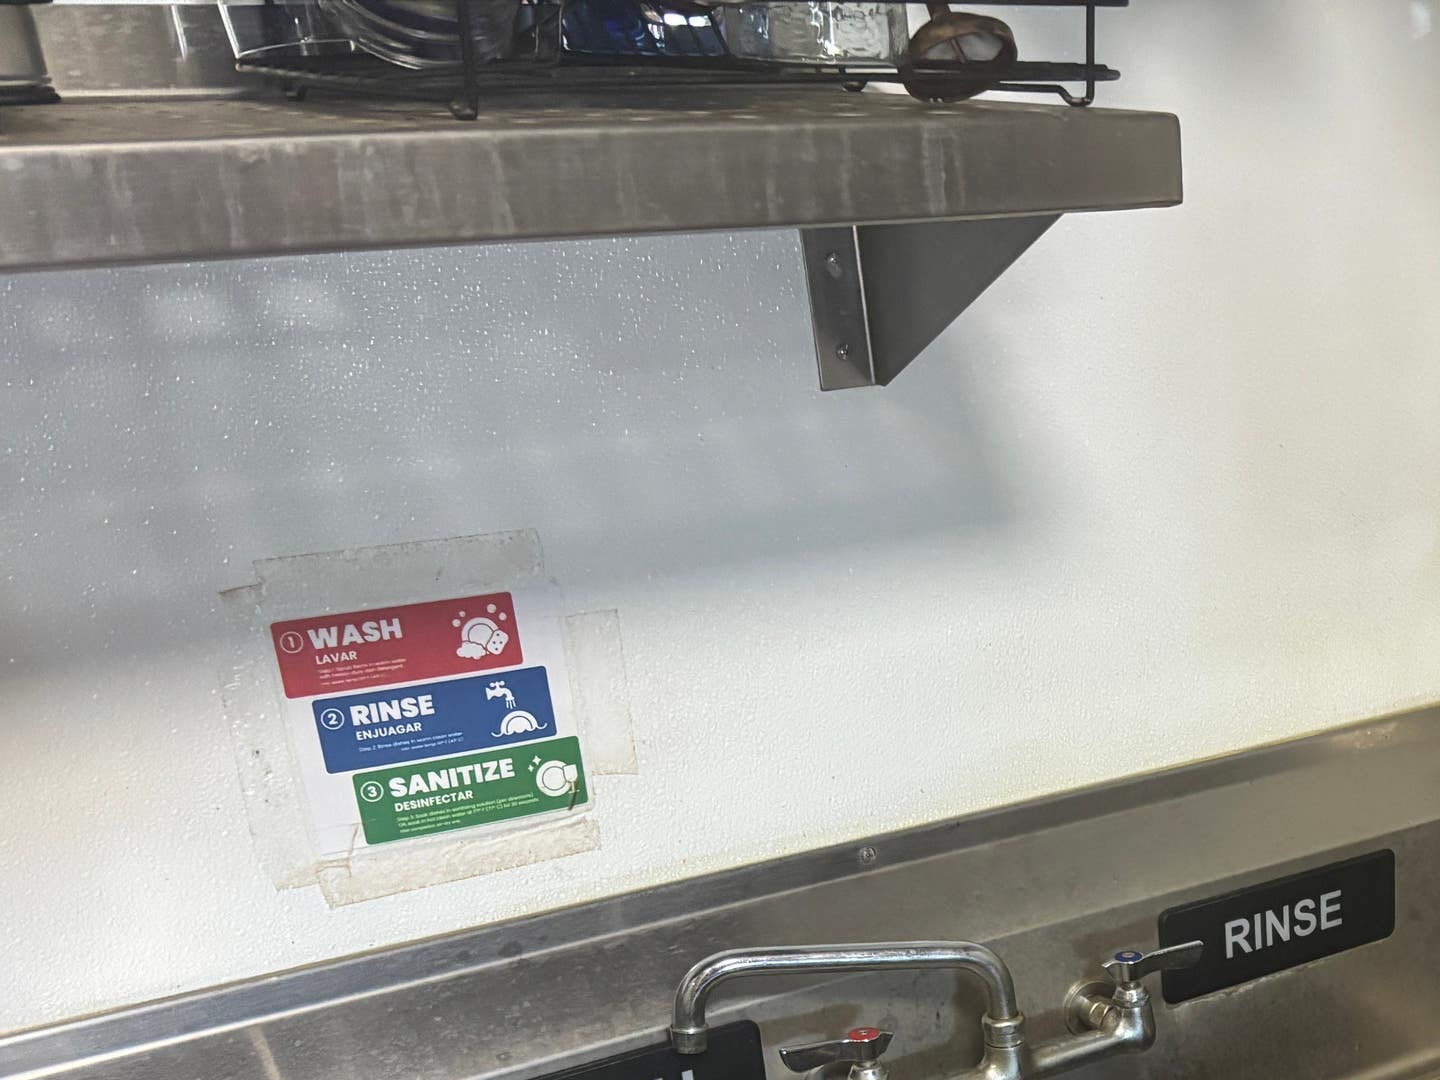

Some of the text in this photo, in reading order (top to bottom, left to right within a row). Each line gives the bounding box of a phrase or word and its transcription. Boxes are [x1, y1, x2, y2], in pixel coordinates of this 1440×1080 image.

[307, 618, 403, 650] WASH
[315, 651, 357, 665] LAVAR
[350, 694, 435, 726] RINSE
[356, 722, 422, 741] ENJUAGAR
[388, 758, 515, 798] SANITIZE
[394, 790, 474, 812] DESINFECTAR
[1224, 890, 1343, 959] RINSE
